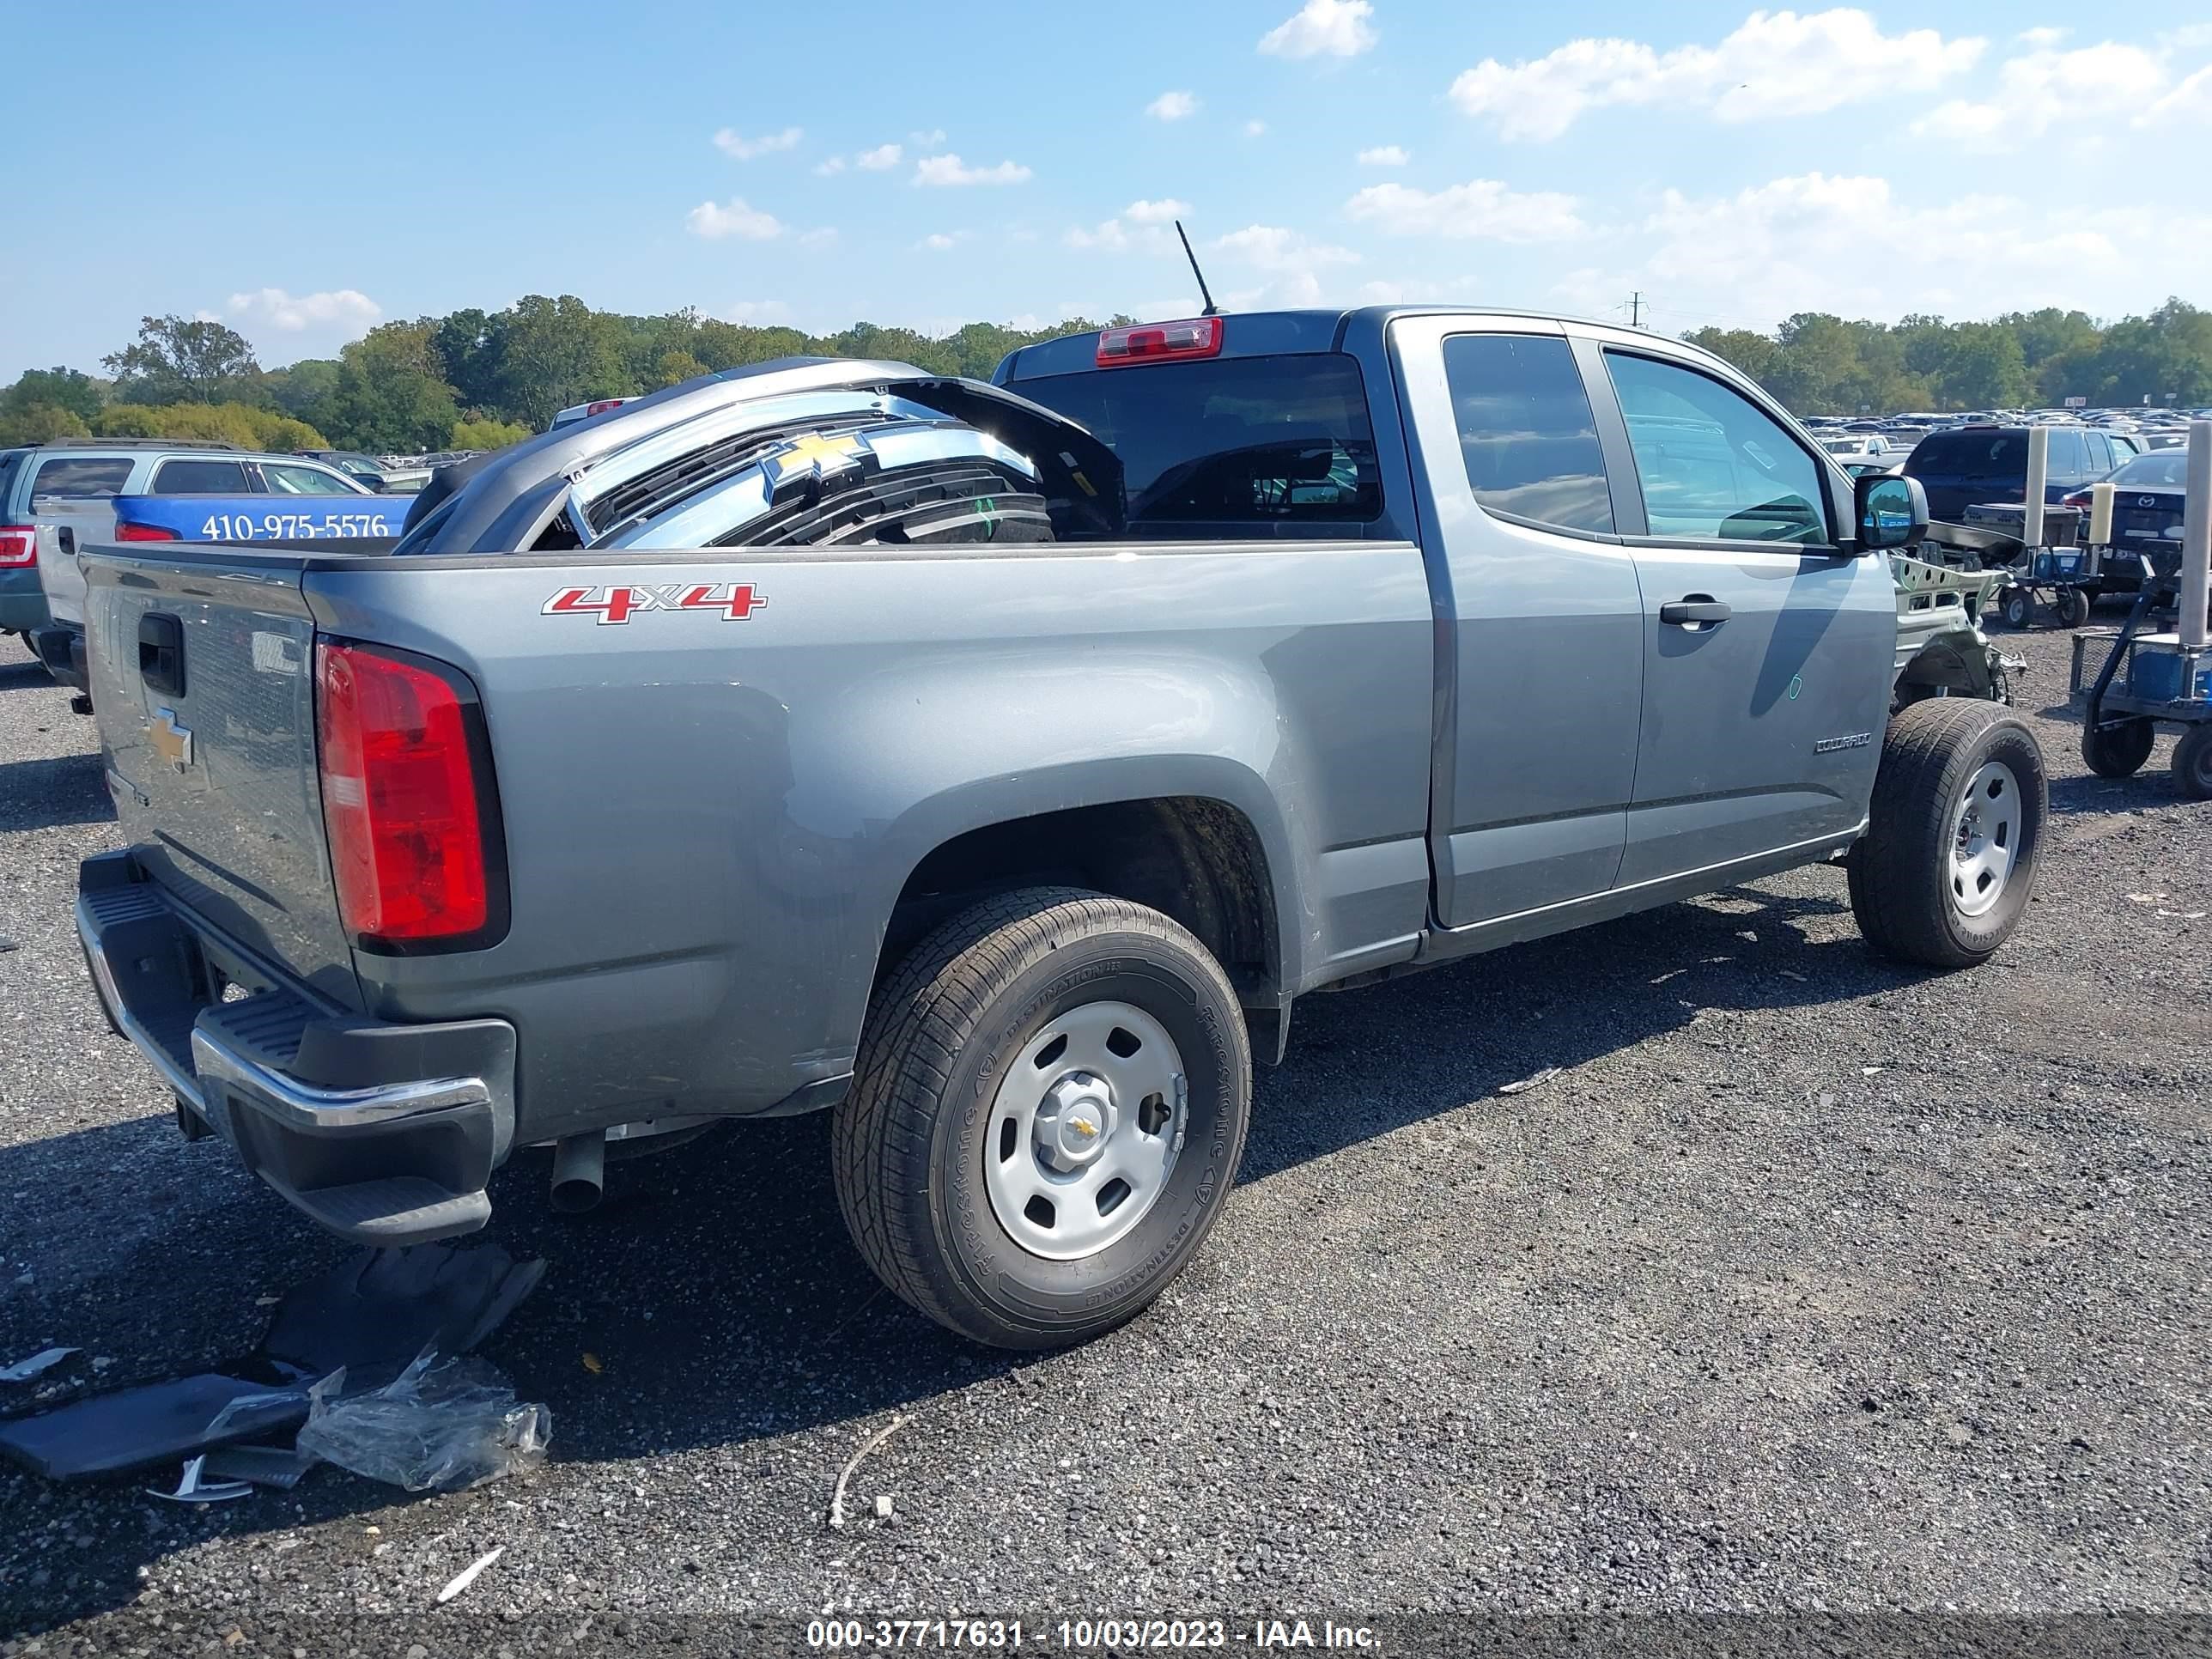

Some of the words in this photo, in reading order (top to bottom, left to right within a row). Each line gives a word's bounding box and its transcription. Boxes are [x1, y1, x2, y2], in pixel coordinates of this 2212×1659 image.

[202, 515, 389, 540] 410-975-5576
[1814, 732, 1872, 753] COLORADO
[1006, 964, 1104, 1039] DESTINATION
[1196, 1005, 1234, 1159] Firestone
[953, 1106, 996, 1276] Firestone
[1103, 1222, 1189, 1300] DESTINATION
